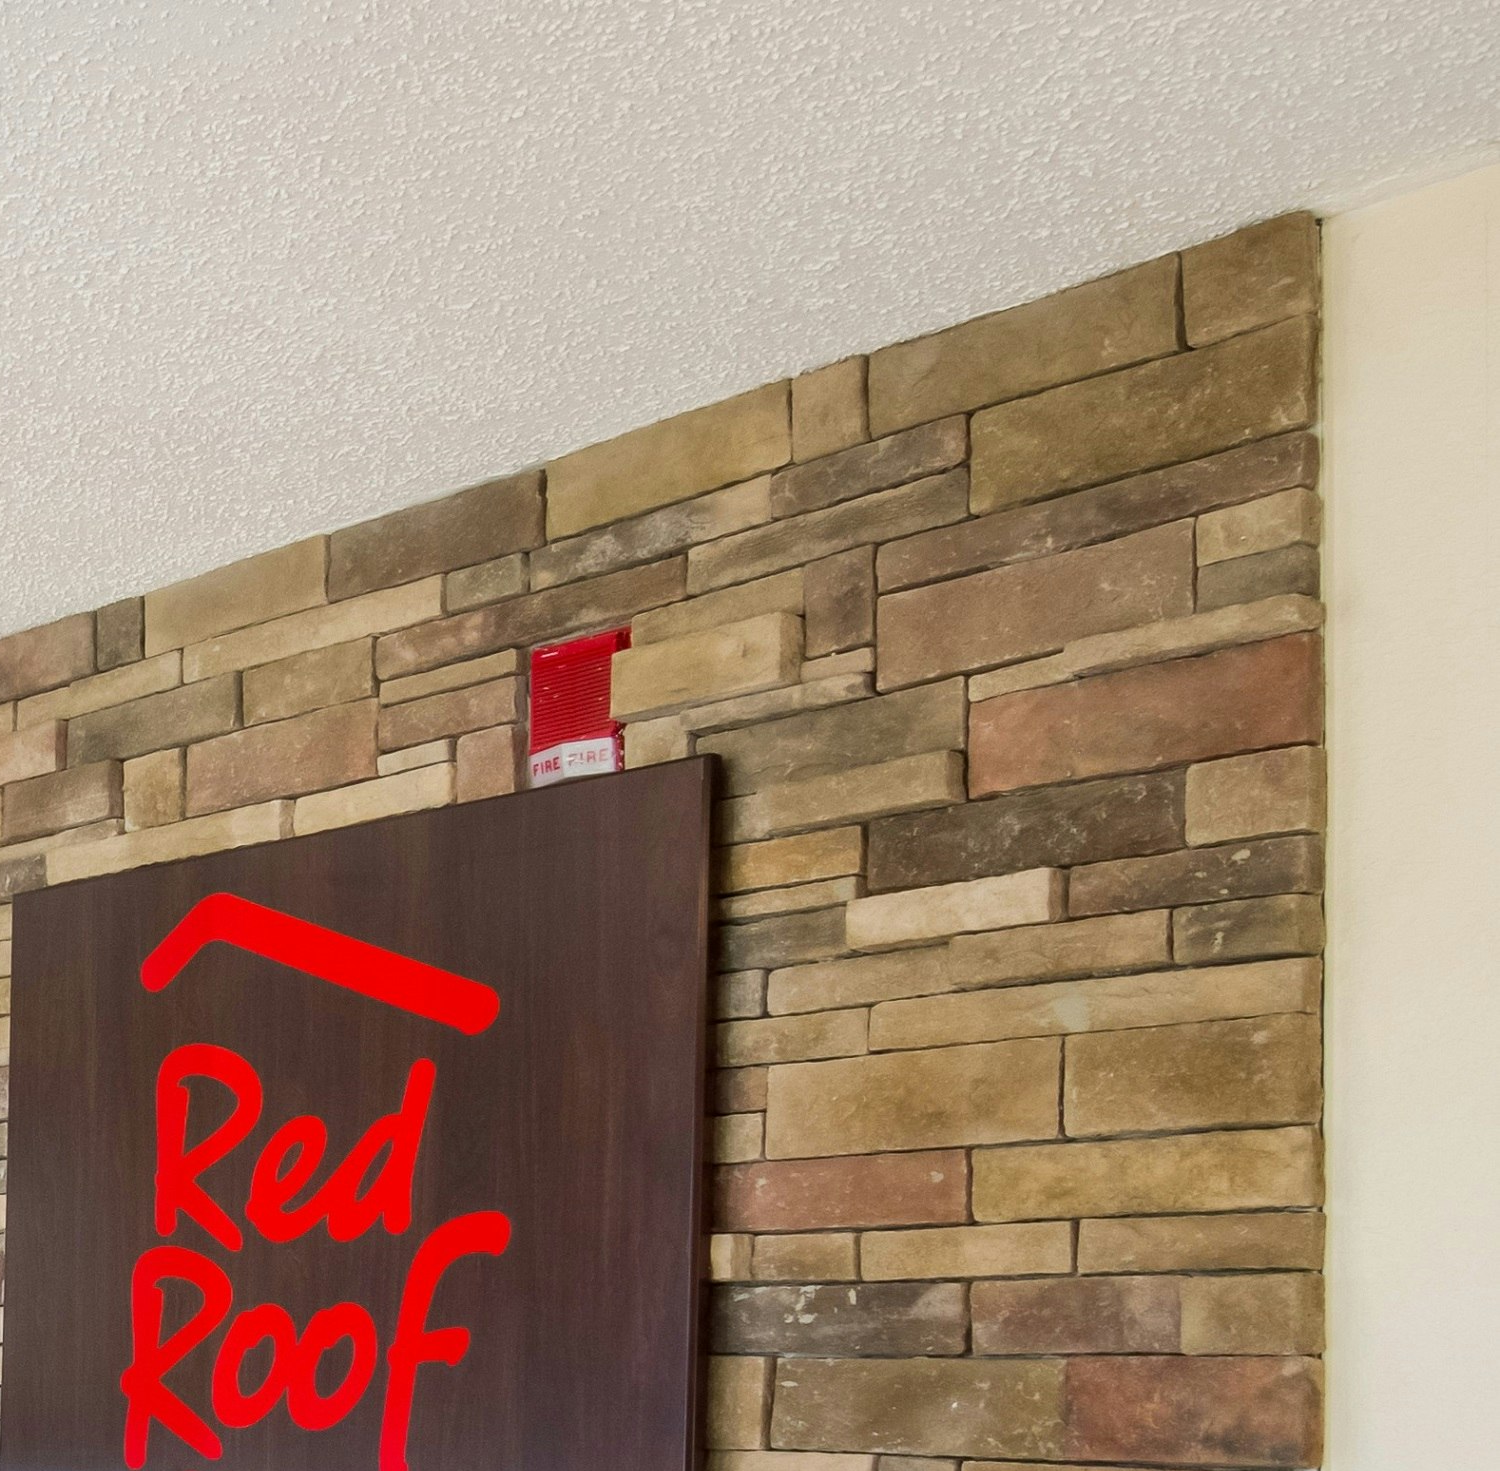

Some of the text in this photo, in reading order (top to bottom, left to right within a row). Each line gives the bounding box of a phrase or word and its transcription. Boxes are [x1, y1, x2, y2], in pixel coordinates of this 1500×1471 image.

[533, 756, 560, 777] FIRE
[568, 748, 609, 767] FIRE
[156, 1044, 436, 1251] Red
